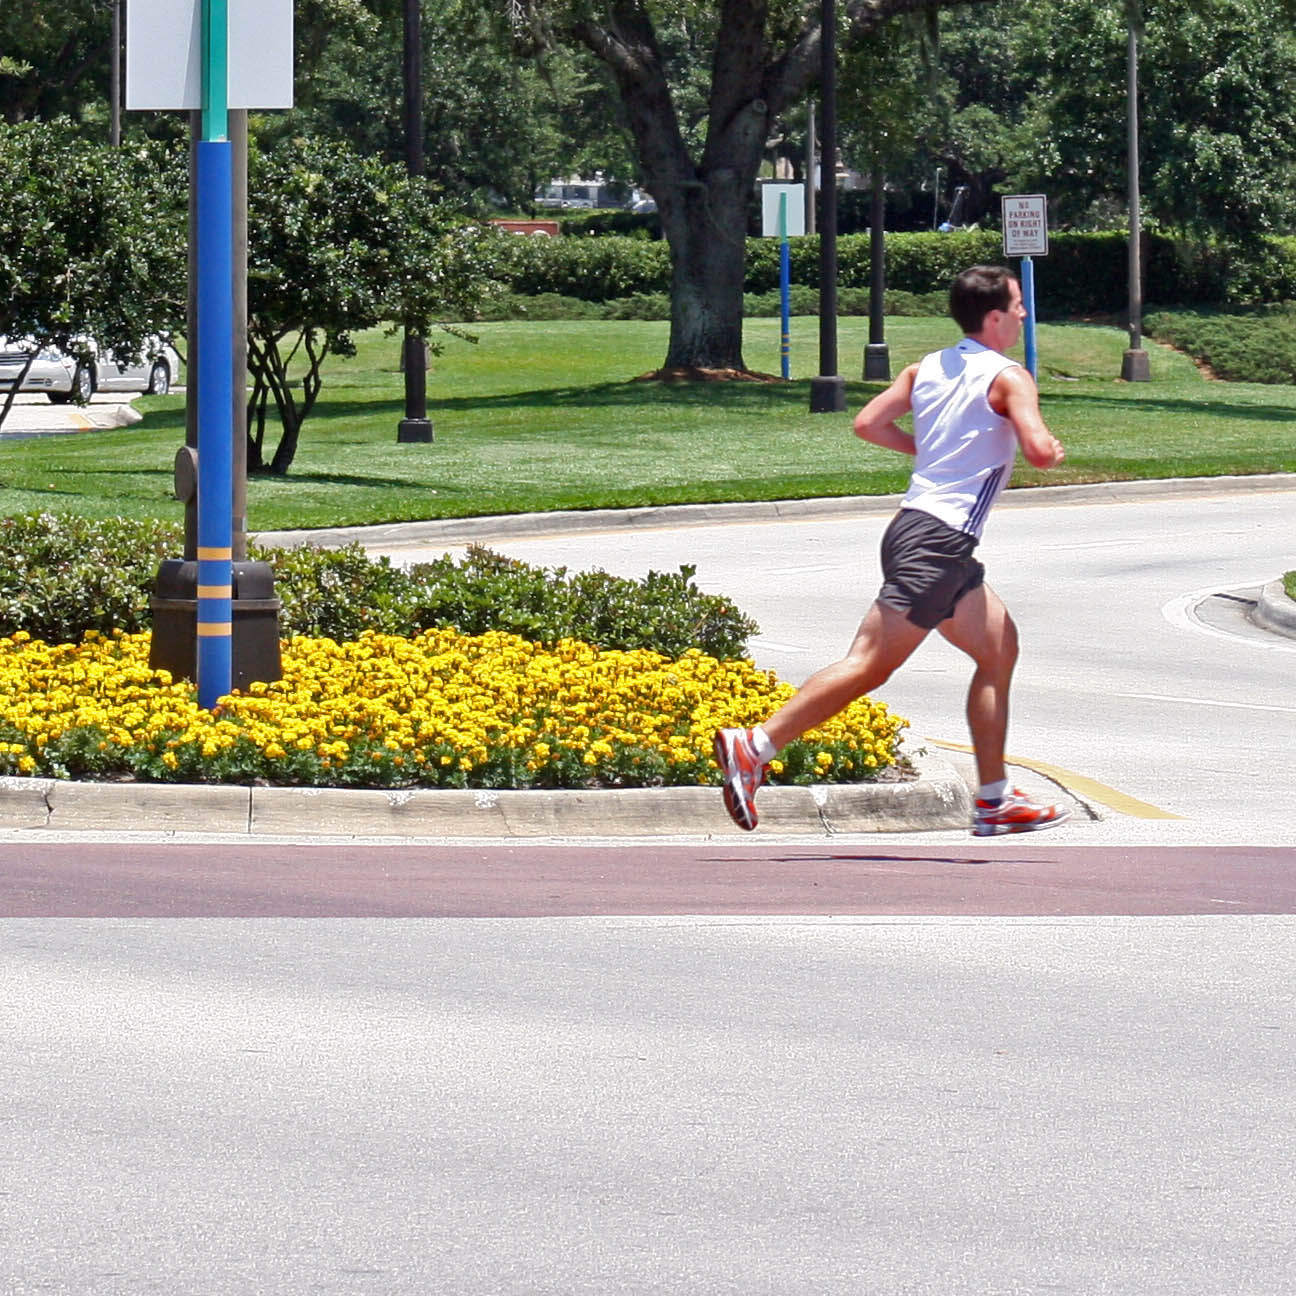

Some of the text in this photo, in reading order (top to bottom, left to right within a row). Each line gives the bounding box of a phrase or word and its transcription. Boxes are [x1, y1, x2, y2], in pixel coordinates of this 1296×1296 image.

[1019, 201, 1029, 209] NO
[1020, 220, 1041, 228] RIGHT
[1023, 229, 1039, 237] WAY
